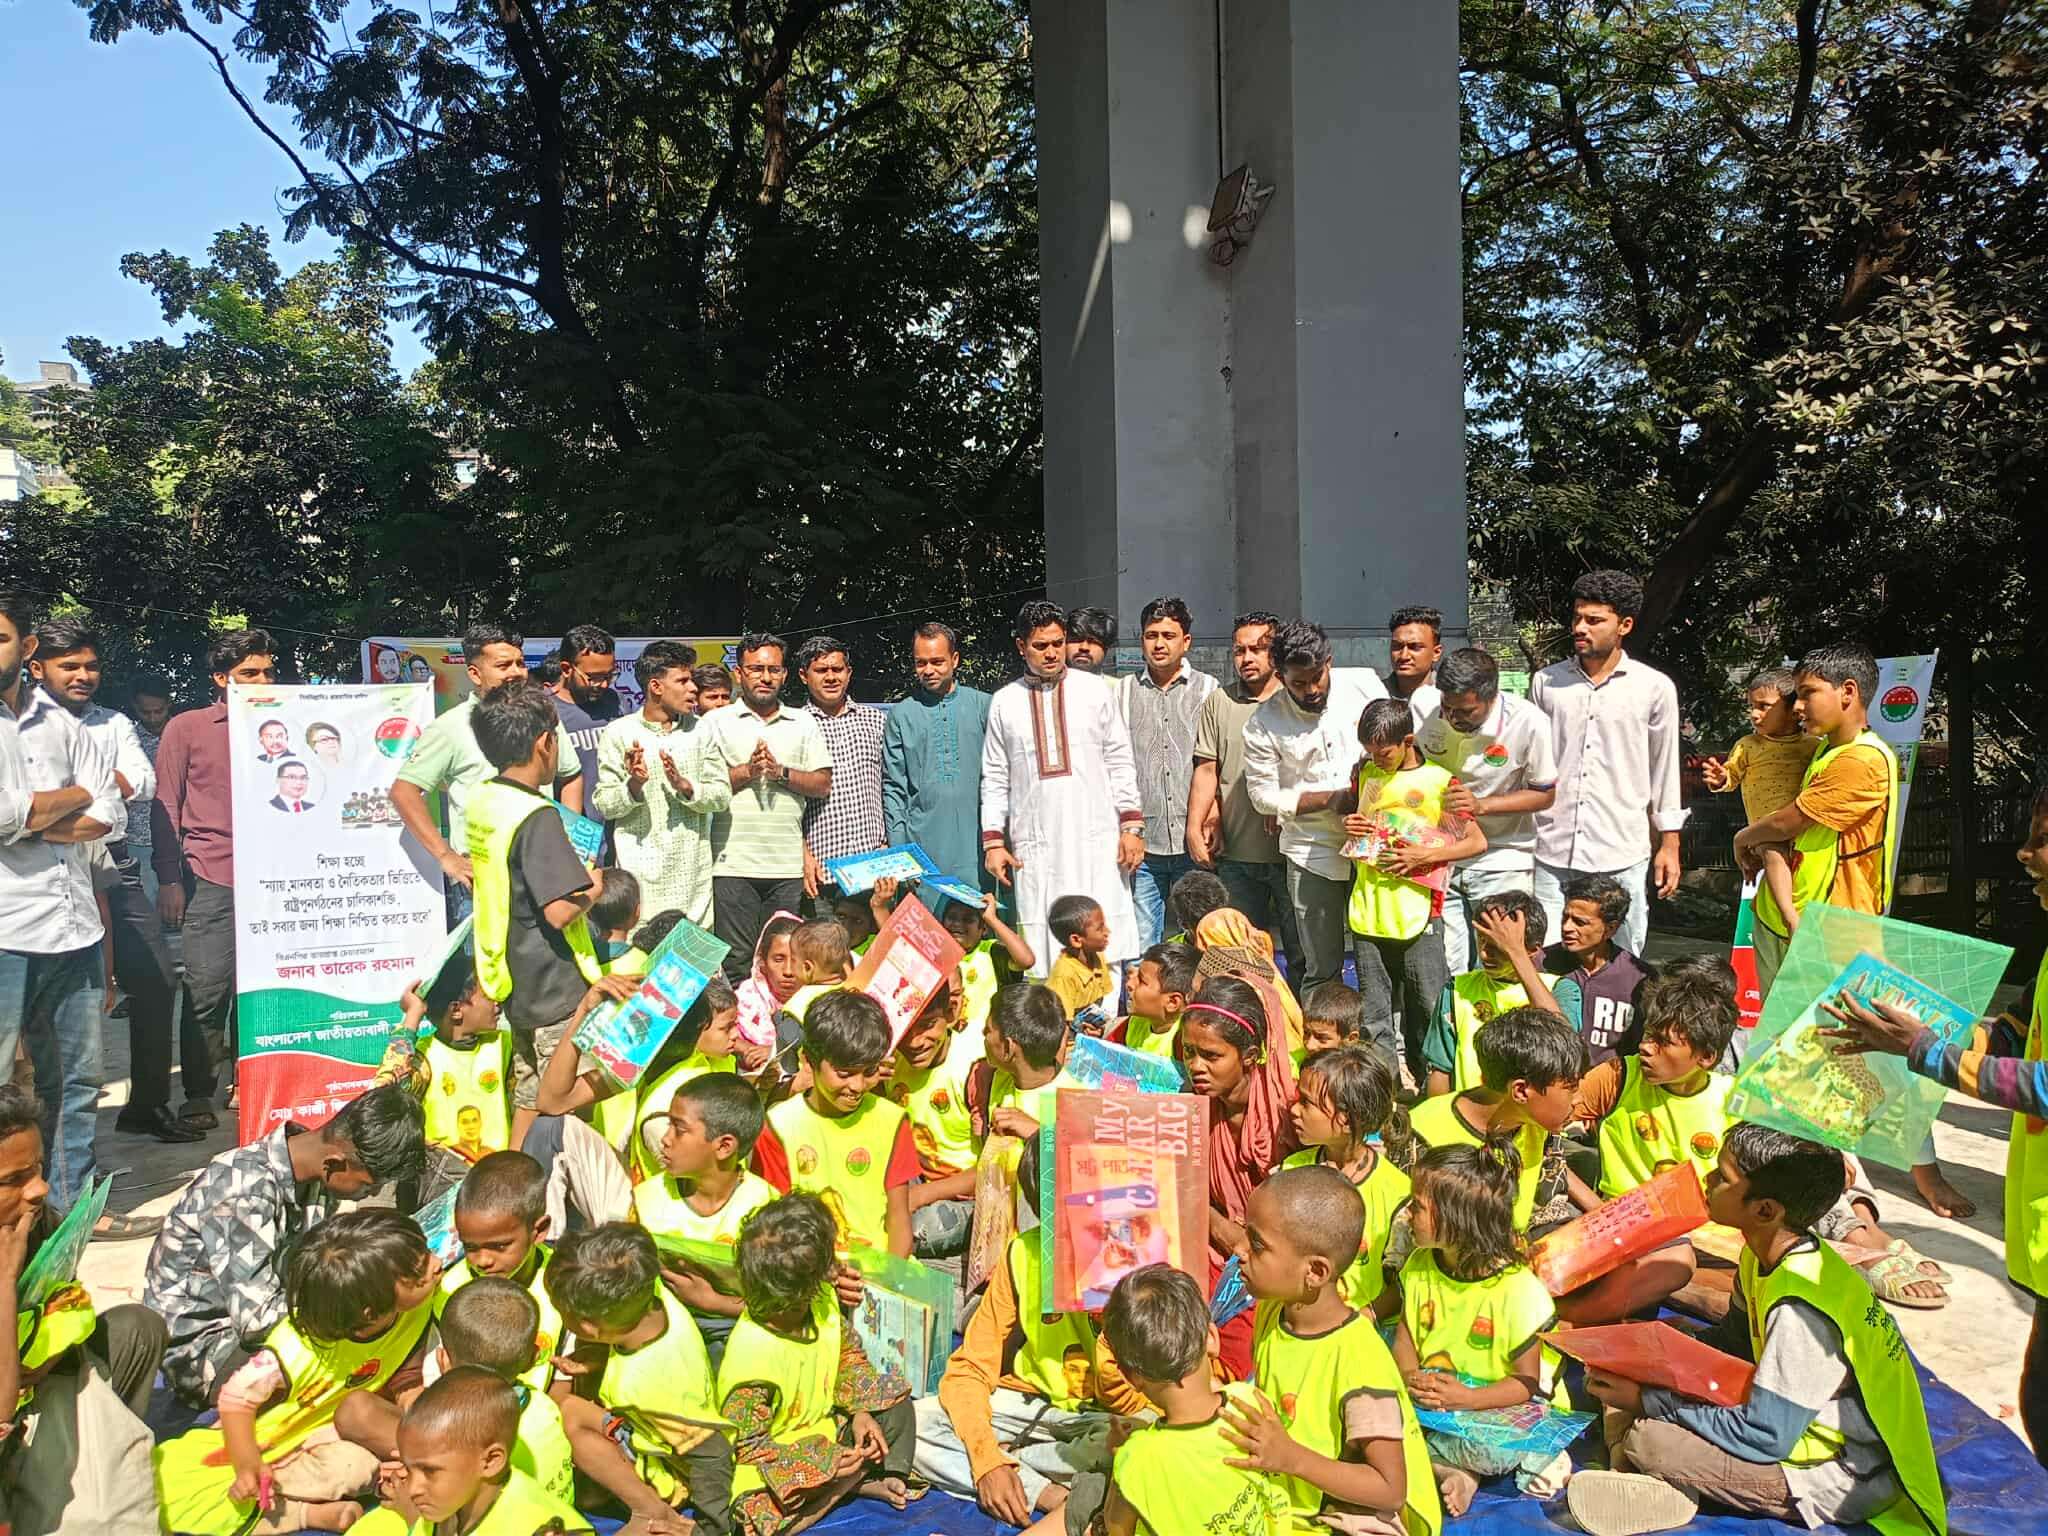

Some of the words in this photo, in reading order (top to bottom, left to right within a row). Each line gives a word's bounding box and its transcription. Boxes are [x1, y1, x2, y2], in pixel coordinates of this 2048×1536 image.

[317, 853, 340, 869] শিক্ষা
[343, 855, 366, 868] হচ্ছে
[327, 878, 336, 889] ও
[338, 872, 385, 889] নৈতিকতার
[388, 869, 422, 885] ভিত্তিতে
[248, 919, 269, 935] তাই
[272, 919, 296, 934] সবার
[300, 918, 319, 931] জন্য
[321, 914, 346, 931] শিক্ষা
[348, 912, 379, 928] নিশ্চিত
[381, 912, 409, 926] করতে
[276, 965, 317, 979] জনাব
[320, 960, 367, 976] তারেক
[371, 957, 416, 972] রহমান
[255, 1031, 313, 1048] বাংলাদেশ
[1093, 1098, 1131, 1144] My
[1157, 1101, 1189, 1158] BAG
